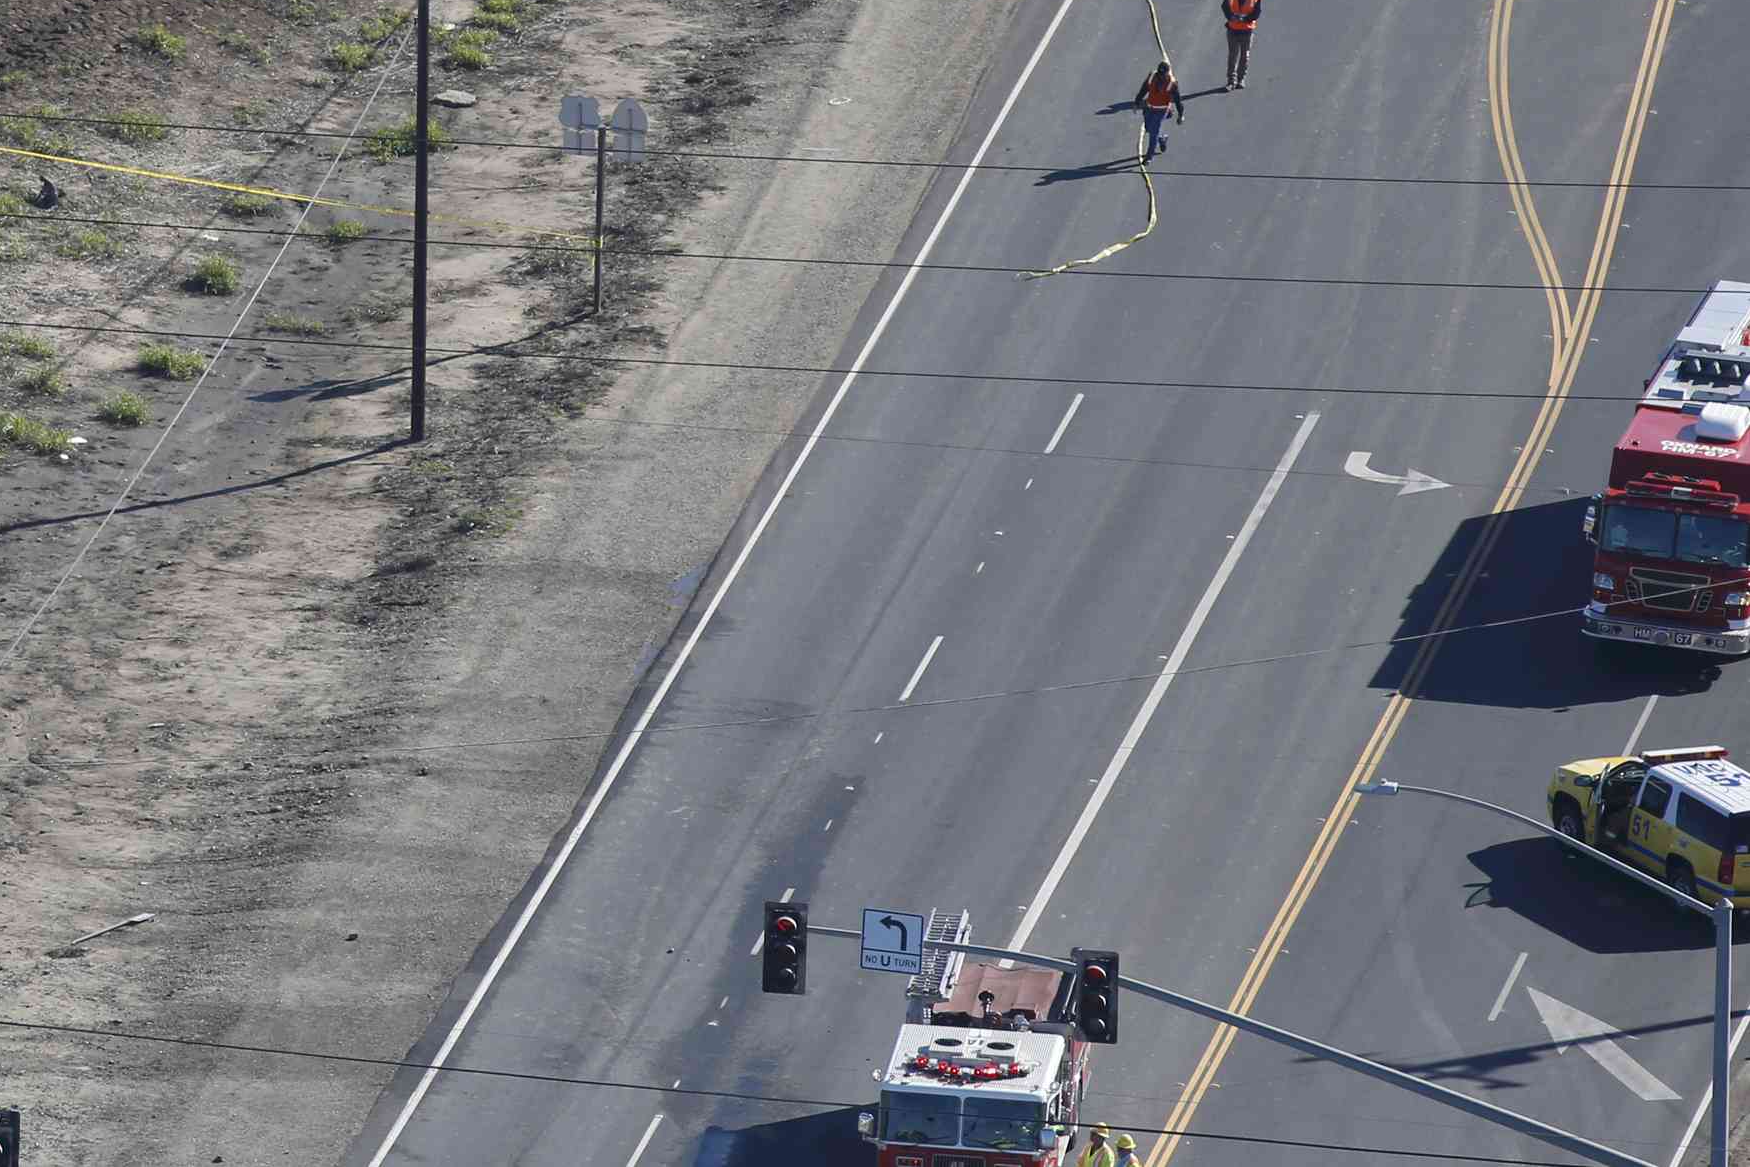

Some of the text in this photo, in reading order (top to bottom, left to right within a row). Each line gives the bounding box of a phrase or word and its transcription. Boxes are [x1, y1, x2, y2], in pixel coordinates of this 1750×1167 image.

[1675, 633, 1691, 644] 67
[1632, 814, 1651, 841] 51
[865, 954, 917, 968] NO U TURN
